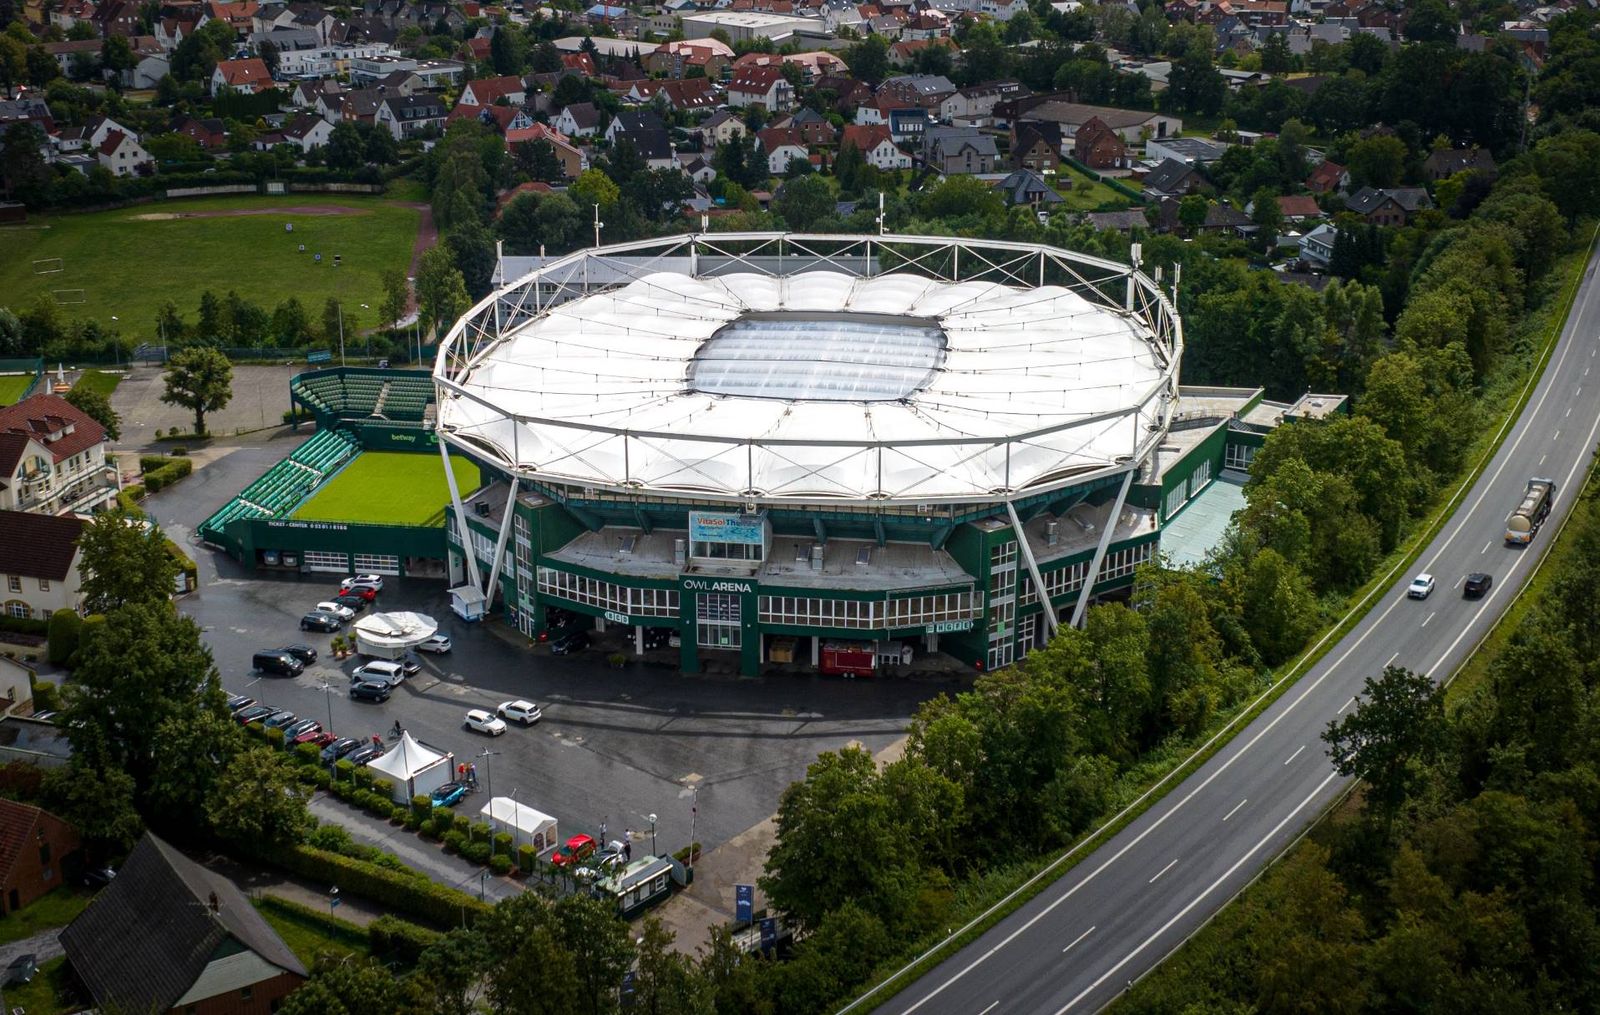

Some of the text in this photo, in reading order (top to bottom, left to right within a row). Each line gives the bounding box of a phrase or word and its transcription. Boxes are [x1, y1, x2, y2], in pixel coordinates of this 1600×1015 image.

[391, 433, 416, 443] betway
[683, 579, 752, 593] OWL ARENA
